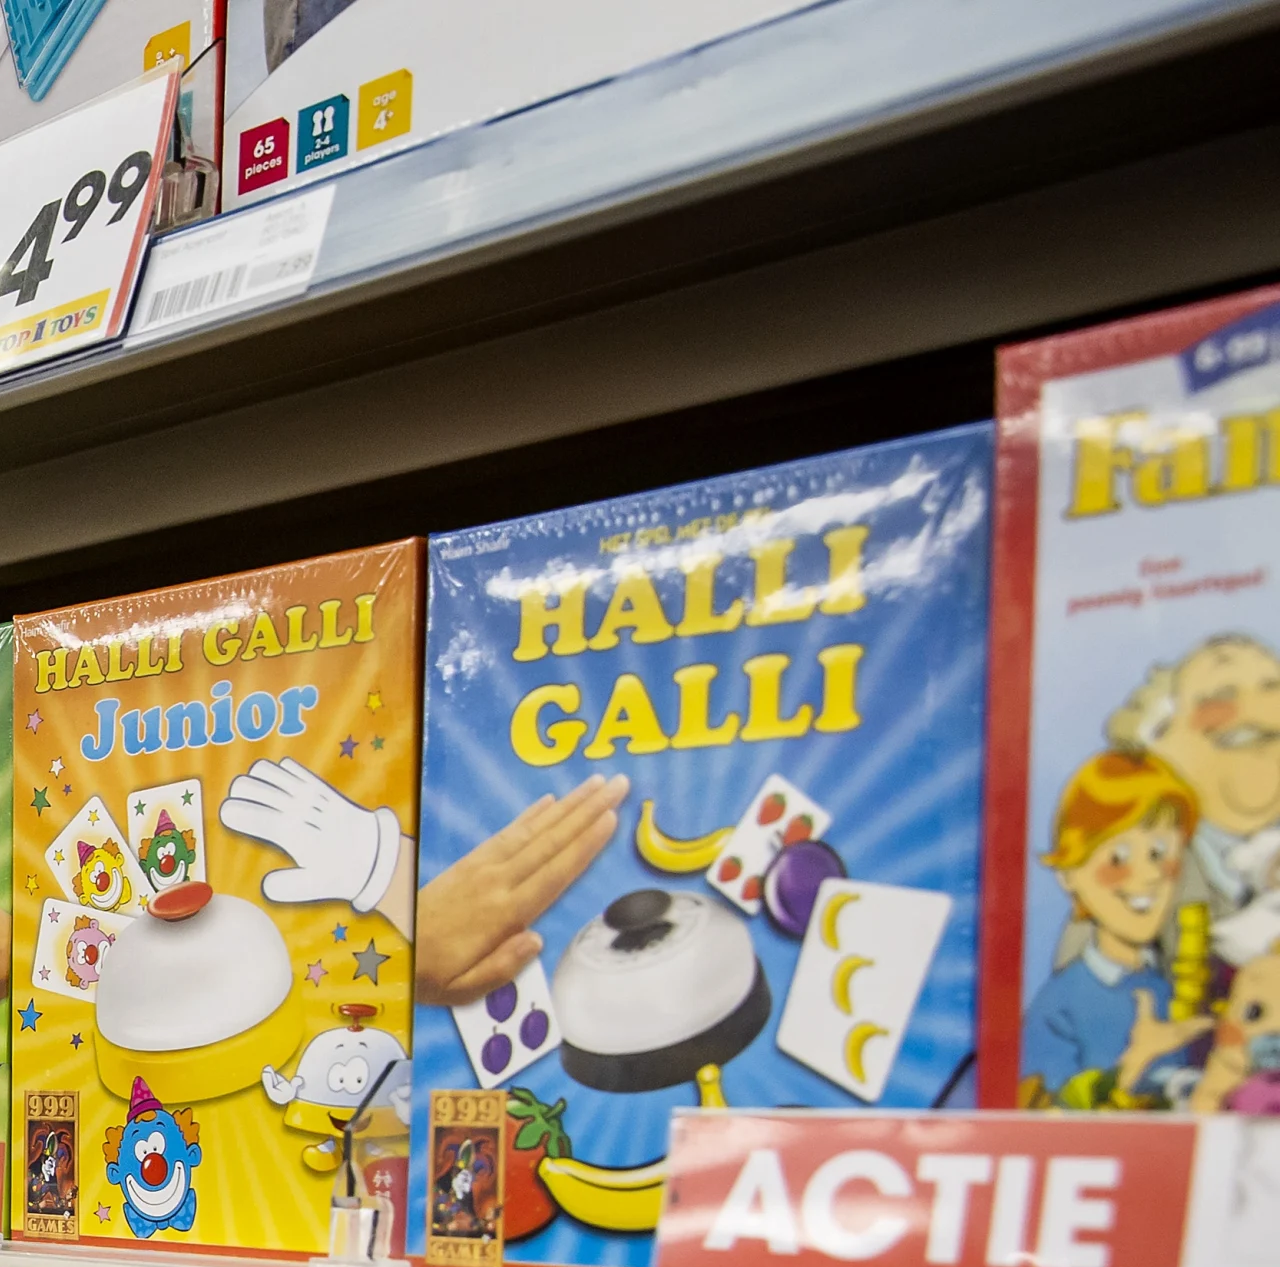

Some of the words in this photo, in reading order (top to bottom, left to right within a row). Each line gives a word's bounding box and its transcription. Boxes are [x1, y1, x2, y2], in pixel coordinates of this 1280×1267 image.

[371, 88, 398, 109] age
[372, 108, 395, 131] 4+
[253, 134, 276, 159] 65
[303, 143, 341, 166] players
[314, 135, 331, 150] 2-4
[244, 155, 283, 180] pieces
[48, 305, 99, 338] TOYS
[512, 525, 870, 662] HALLI
[34, 628, 183, 694] HALLI
[202, 593, 377, 667] GALLI
[510, 643, 865, 768] GALLI
[80, 679, 319, 762] Junior
[28, 1094, 75, 1119] 999
[435, 1097, 499, 1125] 999
[26, 1217, 76, 1236] GAMES
[429, 1240, 500, 1264] GAMES
